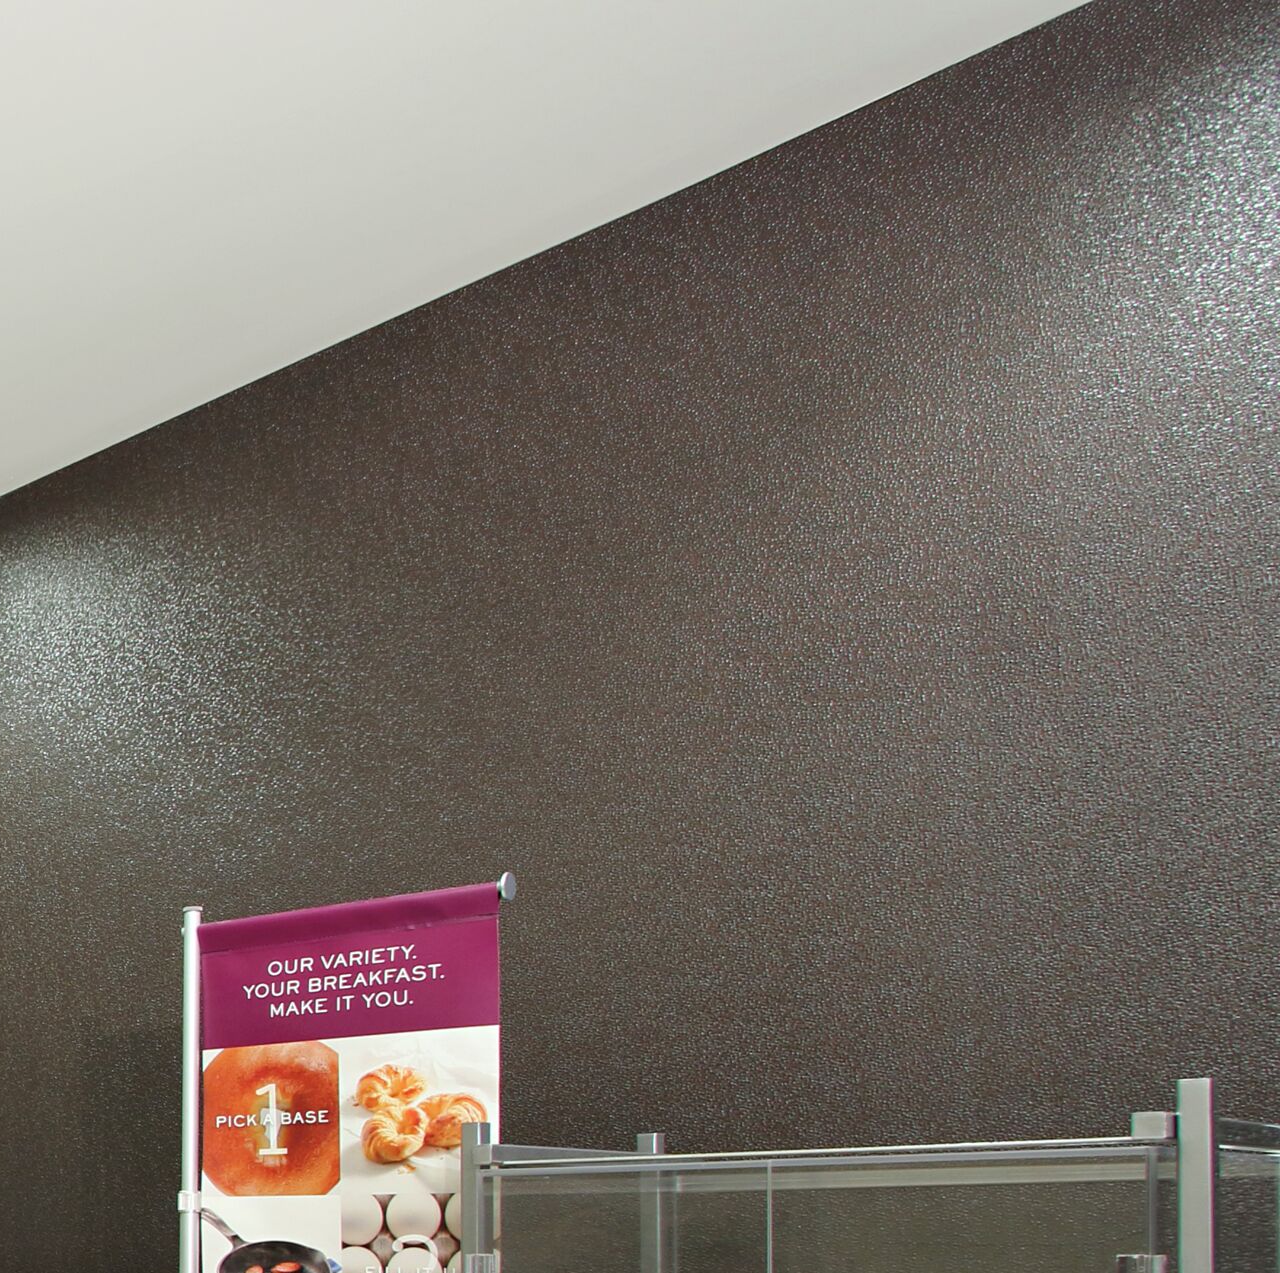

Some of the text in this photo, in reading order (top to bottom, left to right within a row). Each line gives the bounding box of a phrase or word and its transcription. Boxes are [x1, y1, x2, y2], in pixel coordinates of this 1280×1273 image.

[267, 944, 417, 976] OUR VARIETY.
[243, 963, 445, 999] YOUR BREAKFAST.
[269, 989, 414, 1018] MAKE IT YOU.
[216, 1109, 329, 1129] PICK A BASE
[255, 1083, 288, 1156] 1
